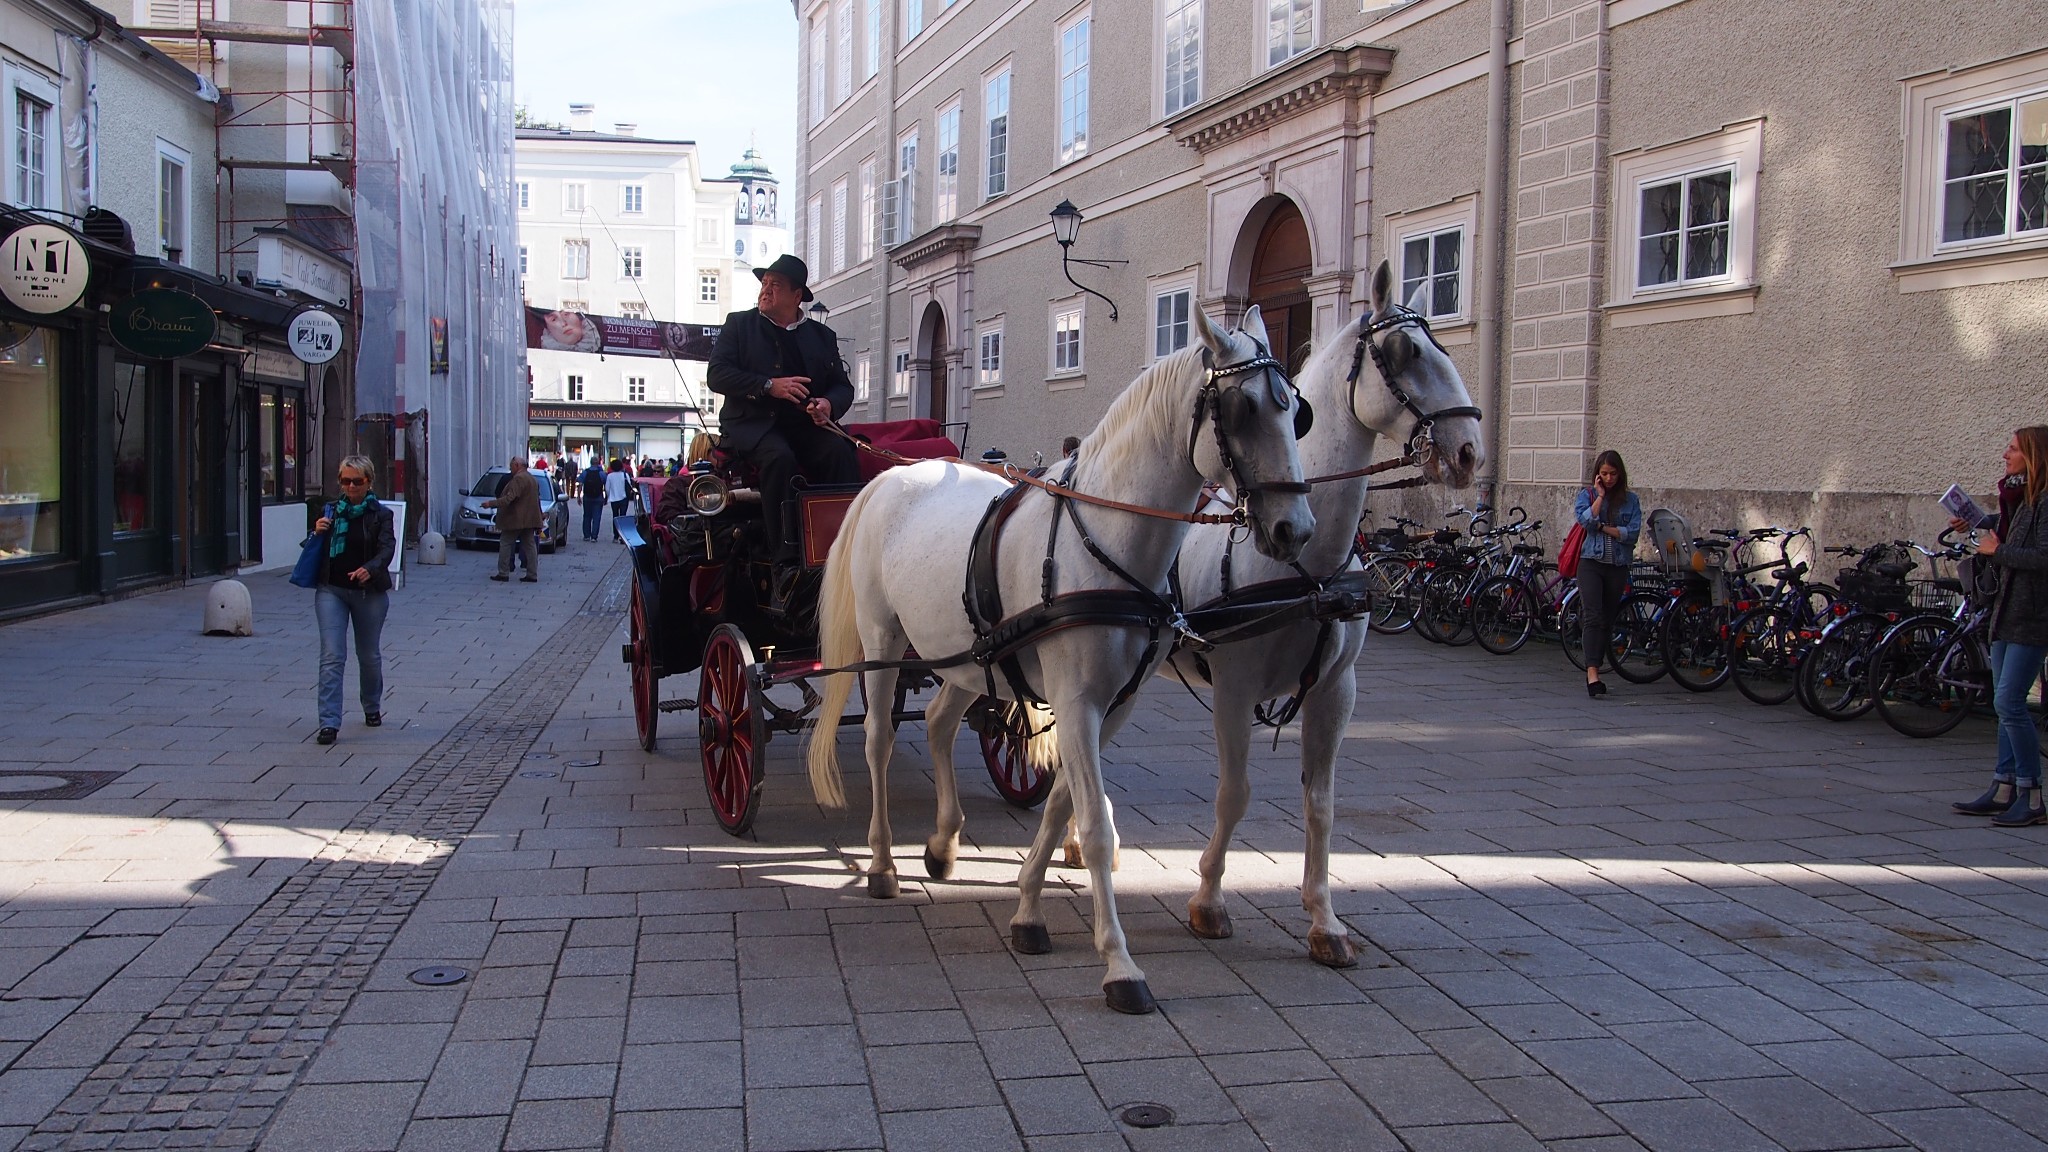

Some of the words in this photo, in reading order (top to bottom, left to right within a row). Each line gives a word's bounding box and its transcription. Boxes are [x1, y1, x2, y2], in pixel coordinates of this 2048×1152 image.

[43, 276, 66, 284] ONE
[604, 317, 622, 326] VON
[623, 319, 658, 329] MENSCH
[606, 324, 618, 332] ZU
[619, 326, 653, 336] MENSCH
[531, 409, 609, 419] RAIFFEISENBANK
